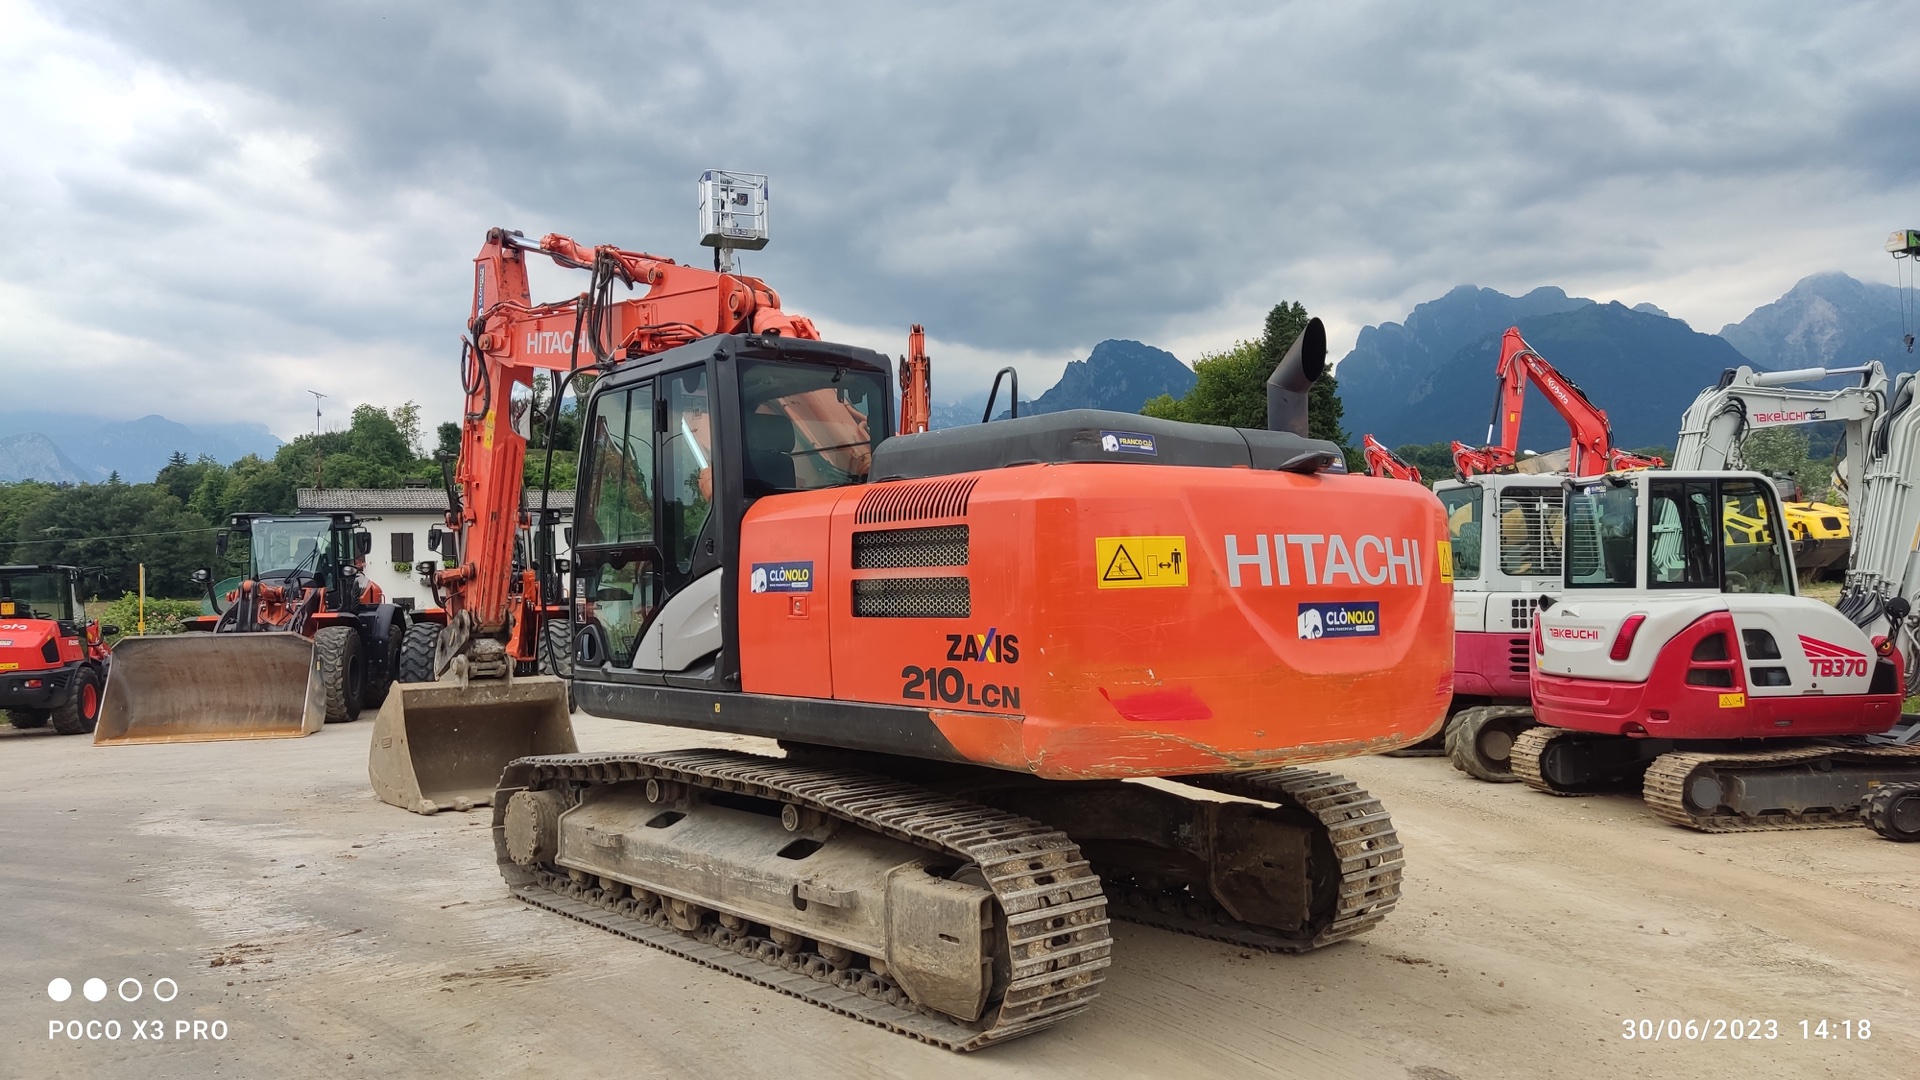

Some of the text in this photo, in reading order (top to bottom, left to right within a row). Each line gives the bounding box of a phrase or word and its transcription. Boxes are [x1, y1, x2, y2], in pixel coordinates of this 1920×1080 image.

[526, 330, 590, 355] HITACHI
[1547, 377, 1569, 404] Kubota
[1753, 411, 1806, 423] TAKEUCHI
[1119, 437, 1142, 446] FRANCO
[1224, 534, 1423, 588] HITACHI
[1549, 628, 1599, 640] TAKEUCHI
[946, 627, 1019, 664] ZAXIS
[1808, 658, 1868, 678] TB370
